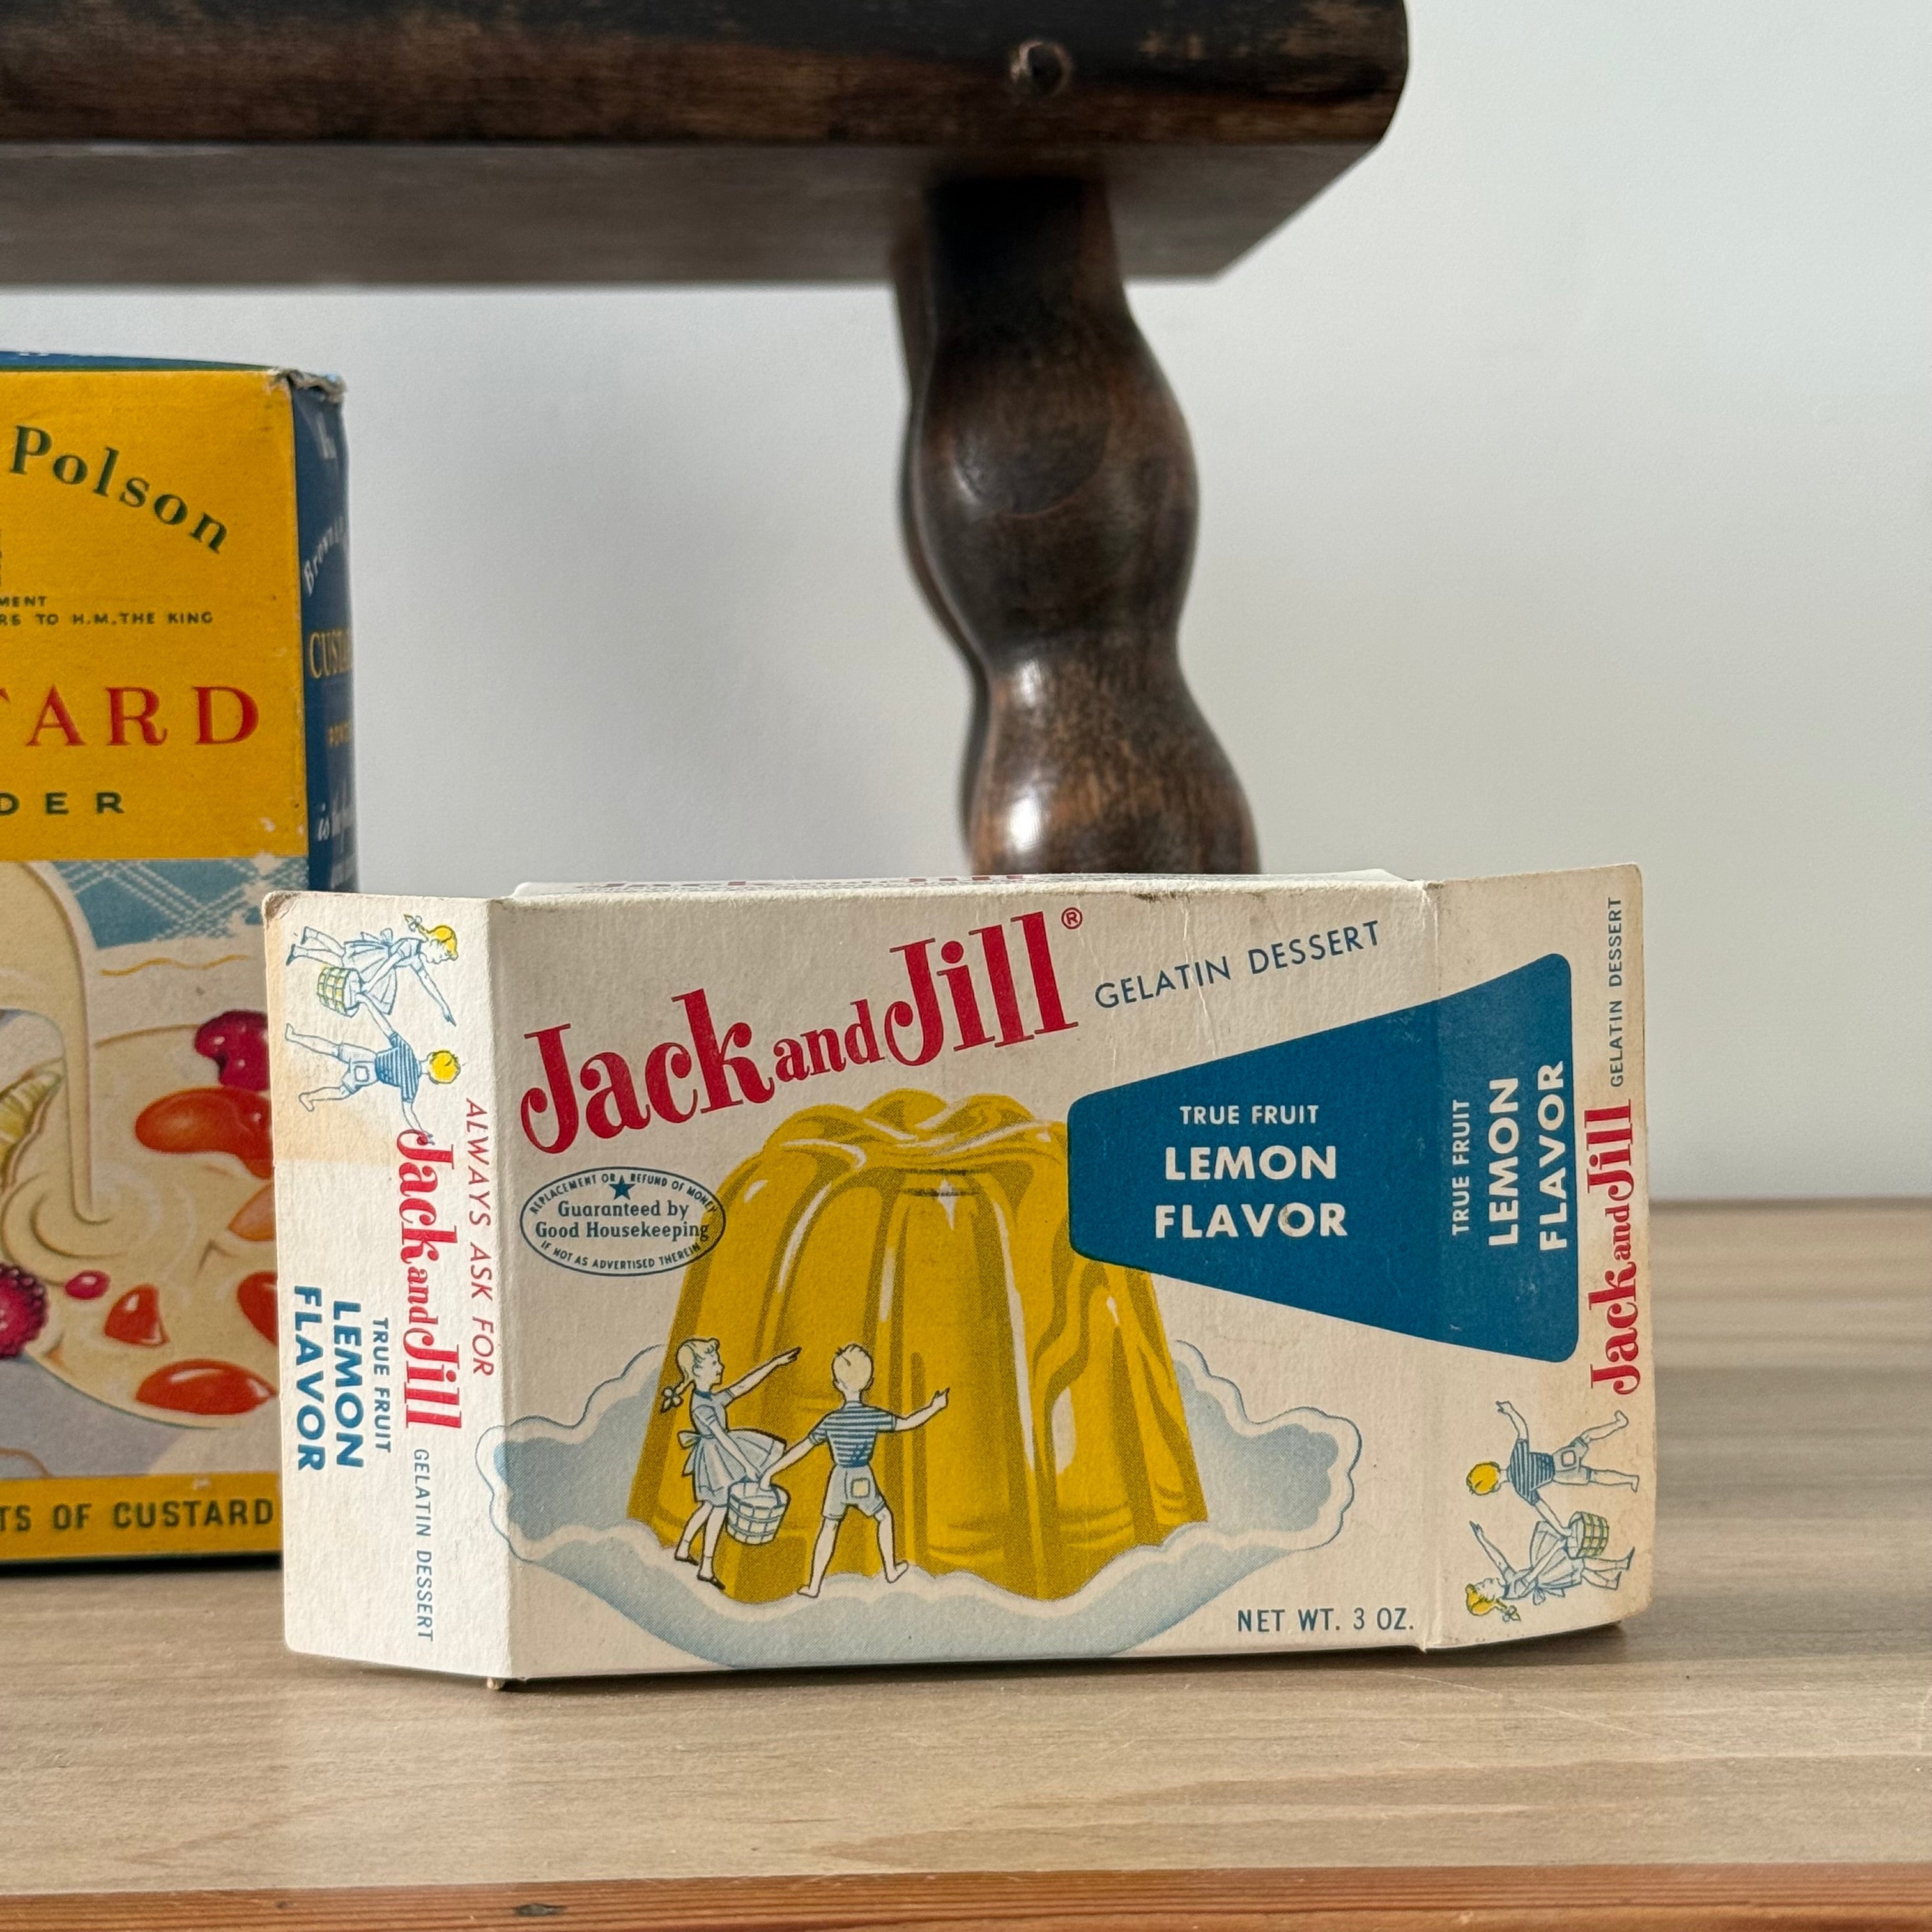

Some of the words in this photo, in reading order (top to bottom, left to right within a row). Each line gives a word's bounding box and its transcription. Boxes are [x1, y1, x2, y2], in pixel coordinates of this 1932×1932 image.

[9, 425, 227, 554] Polson
[34, 613, 59, 625] TO
[167, 611, 213, 624] KING
[0, 683, 259, 746] ARD
[1094, 956, 1231, 1009] GELATIN
[1248, 919, 1379, 975] DESSERT
[1607, 896, 1623, 988] DESSERT
[519, 988, 774, 1154] Jack
[773, 999, 885, 1084] and
[884, 910, 1079, 1066] Jill
[1608, 1000, 1624, 1088] GELATIN
[1179, 1105, 1239, 1125] TRUE
[1252, 1105, 1319, 1124] FRUIT
[1452, 1099, 1470, 1166] FRUIT
[466, 1097, 491, 1227] ALWAYS
[1165, 1145, 1337, 1181] LEMON
[1488, 1077, 1519, 1246] LEMON
[1537, 1061, 1568, 1252] FLAVOR
[1584, 1098, 1635, 1202] Jill
[397, 1128, 458, 1263] Jack
[529, 1173, 597, 1215] REPLACEMENT
[601, 1173, 616, 1182] OR
[630, 1173, 668, 1187] REFUND
[671, 1180, 685, 1192] OF
[686, 1185, 720, 1214] MONEY
[558, 1200, 661, 1218] Guaranteed
[667, 1200, 690, 1220] by
[1154, 1202, 1349, 1239] FLAVOR
[1452, 1174, 1470, 1237] TRUE
[535, 1221, 579, 1238] Good
[586, 1221, 710, 1242] Housekeeping
[540, 1239, 552, 1250] IF
[553, 1248, 573, 1261] NOT
[574, 1255, 589, 1267] AS
[592, 1257, 656, 1270] ADVERTISED
[658, 1241, 702, 1266] THEREIN
[1605, 1203, 1632, 1261] and
[406, 1266, 439, 1325] and
[470, 1241, 494, 1301] ASK
[372, 1317, 390, 1376] TRUE
[471, 1315, 494, 1376] FOR
[1588, 1261, 1641, 1395] Jack
[294, 1285, 325, 1471] FLAVOR
[333, 1300, 364, 1468] LEMON
[402, 1327, 462, 1429] Jill
[374, 1387, 392, 1453] FRUIT
[53, 1503, 93, 1531] OF
[113, 1498, 274, 1529] CUSTARD
[414, 1448, 432, 1537] GELATIN
[416, 1550, 433, 1641] DESSERT
[1237, 1608, 1286, 1632] NET
[1297, 1607, 1340, 1632] WT.
[1353, 1607, 1365, 1630] 3
[1376, 1607, 1414, 1630] OZ.
